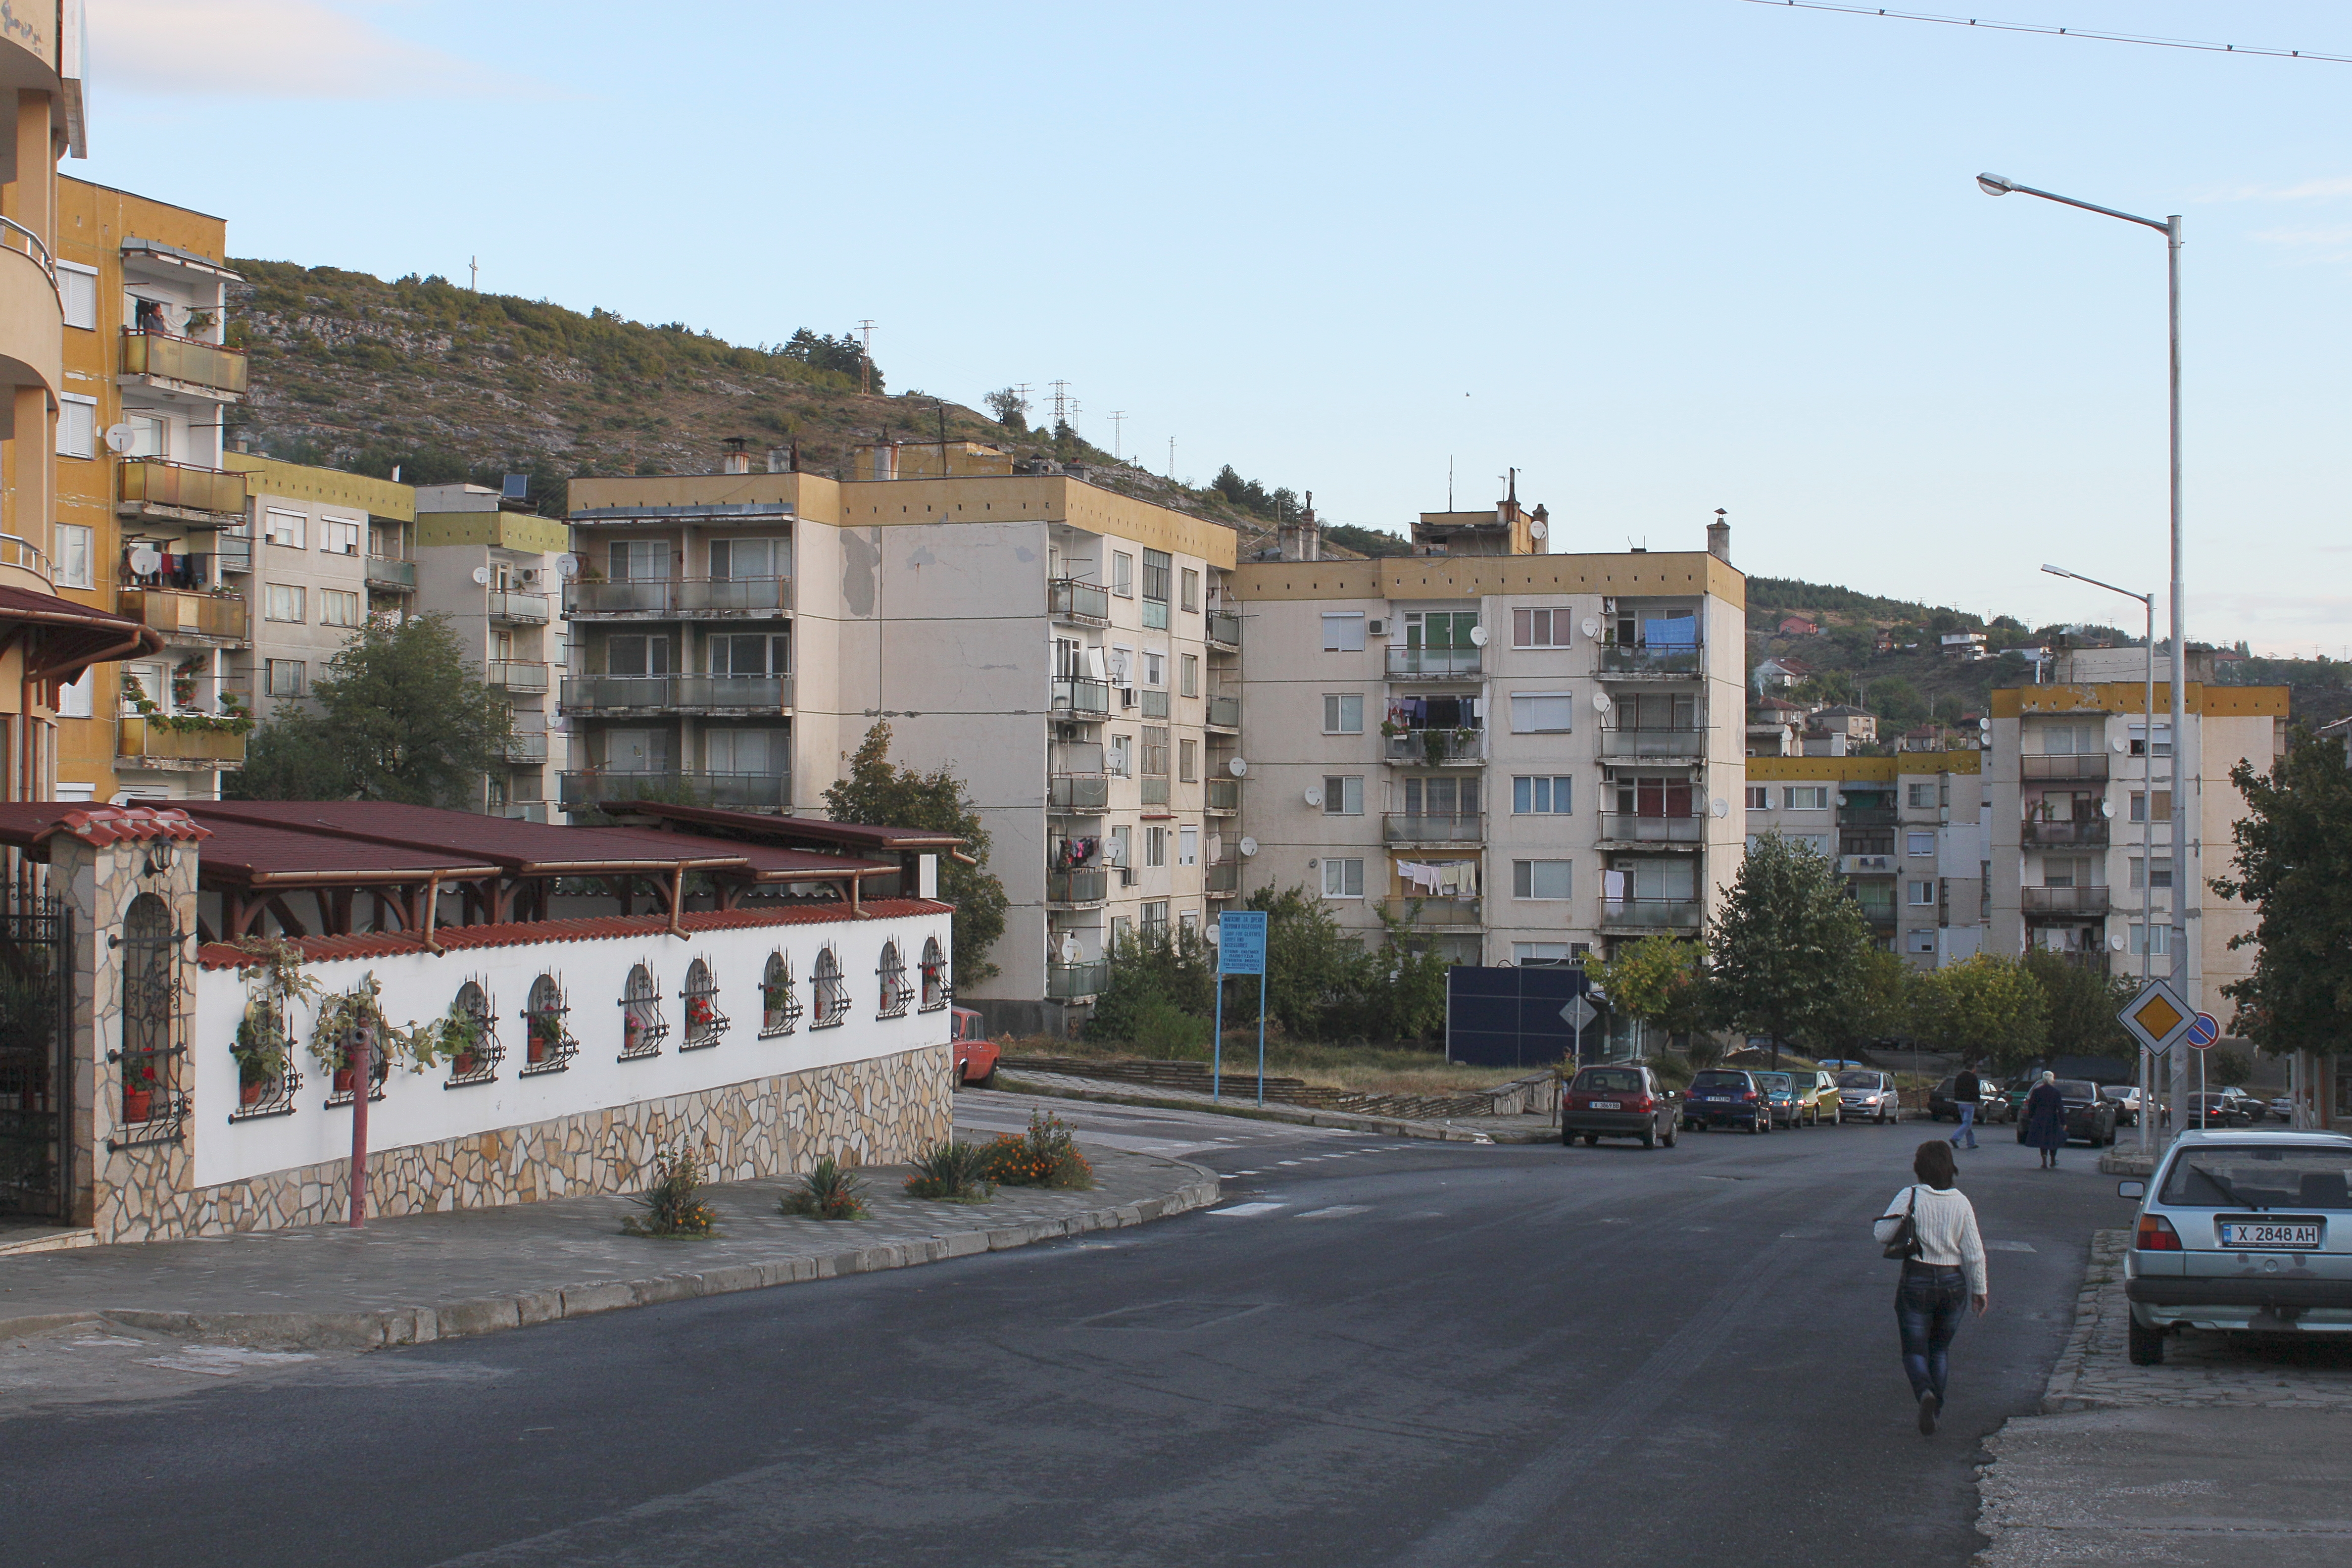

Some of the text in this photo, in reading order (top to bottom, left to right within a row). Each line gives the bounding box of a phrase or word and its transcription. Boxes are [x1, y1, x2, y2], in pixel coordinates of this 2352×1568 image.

[2238, 1226, 2315, 1242] X 2848 AH
